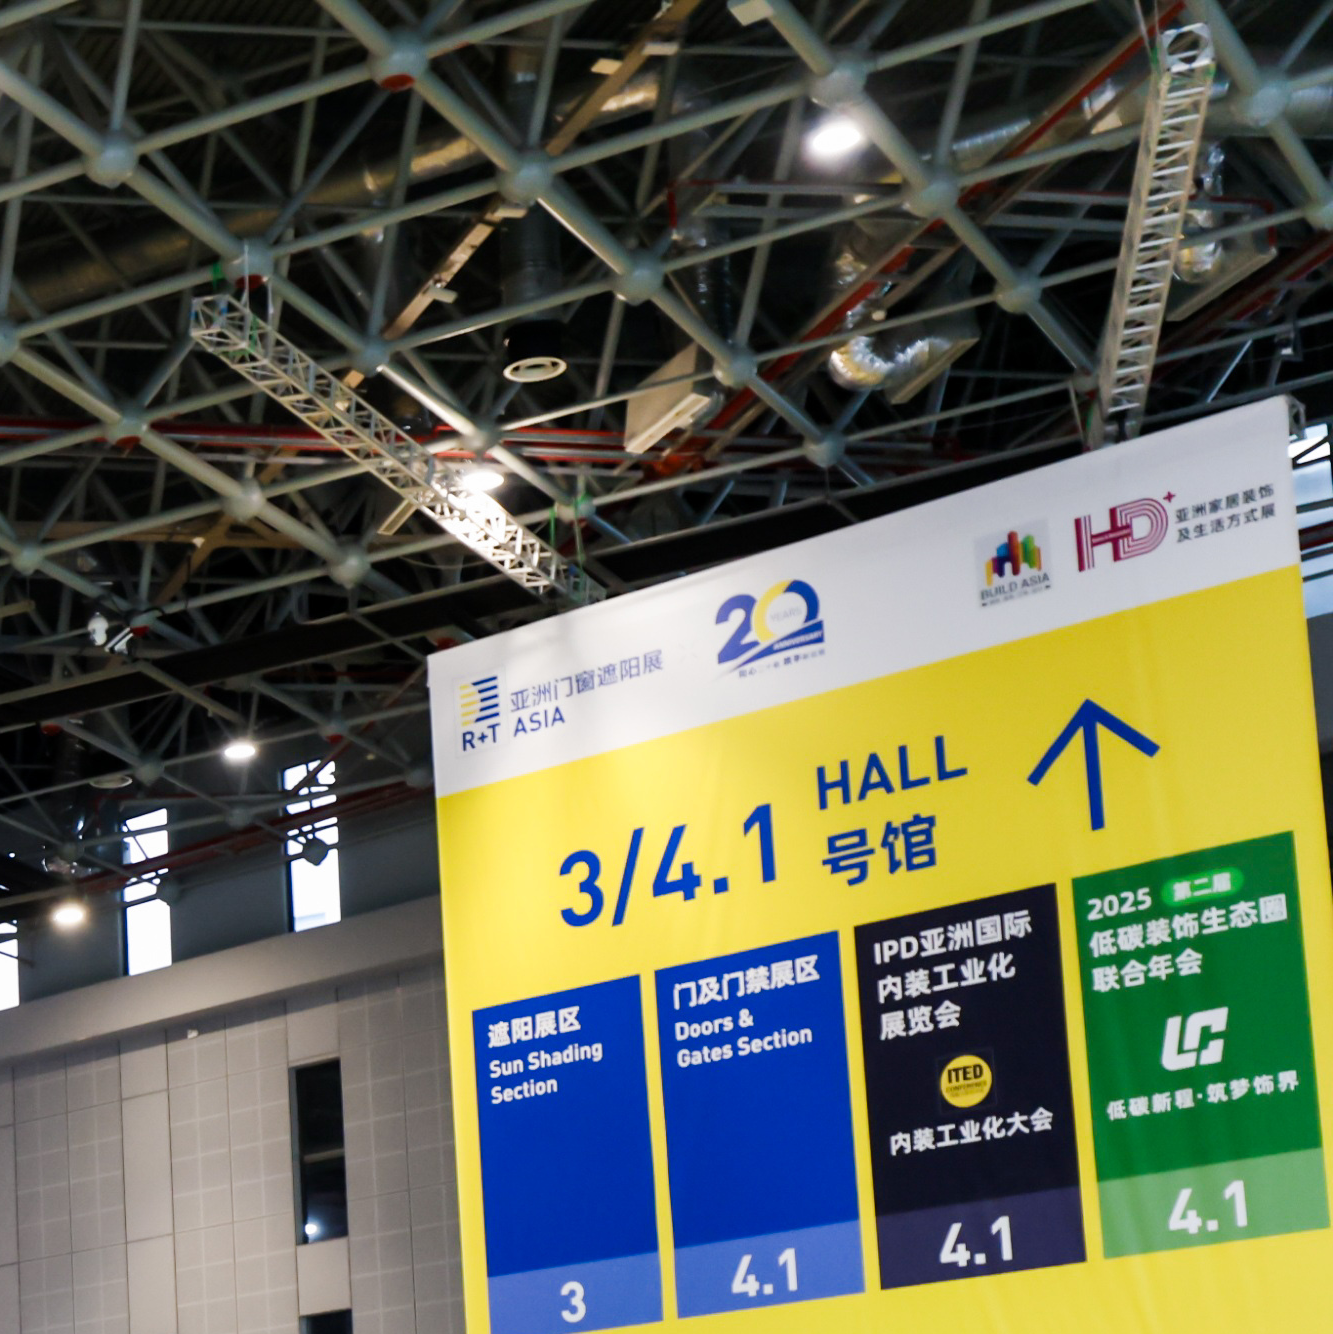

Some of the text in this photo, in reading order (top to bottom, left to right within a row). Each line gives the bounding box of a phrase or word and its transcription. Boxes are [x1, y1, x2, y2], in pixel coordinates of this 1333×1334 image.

[1175, 484, 1274, 523] 亚洲家居装饰
[1176, 503, 1276, 543] 及生活方式展
[980, 579, 1019, 601] BUILD
[1021, 572, 1051, 591] ASIA
[510, 649, 664, 713] 亚洲门窗遮阳展
[461, 723, 501, 752] R+T
[513, 706, 566, 738] ASIA
[816, 733, 969, 811] HALL
[558, 802, 778, 929] 3/4.1
[822, 812, 939, 889] 号馆
[1086, 885, 1154, 922] 2025
[1171, 873, 1233, 902] 第二届
[873, 908, 1034, 965] IPD亚洲国际
[1089, 891, 1289, 959] 低碳装饰生态圈
[672, 953, 821, 1011] 门及门禁展区
[878, 952, 1017, 1004] 内装工业化
[1092, 947, 1204, 994] 联合年会
[486, 1003, 582, 1049] 遮阳展区
[674, 1007, 755, 1043] Doors &
[879, 1000, 962, 1040] 展览会
[488, 1039, 605, 1079] Sun Shading
[677, 1024, 814, 1069] Gates Section
[490, 1073, 559, 1106] Section
[947, 1063, 984, 1085] ITED
[889, 1106, 1055, 1157] 内装工业化大会
[1167, 1178, 1251, 1235] 4.1
[938, 1214, 1015, 1268] 4.1
[730, 1247, 800, 1299] 4.1
[559, 1281, 588, 1324] 3
